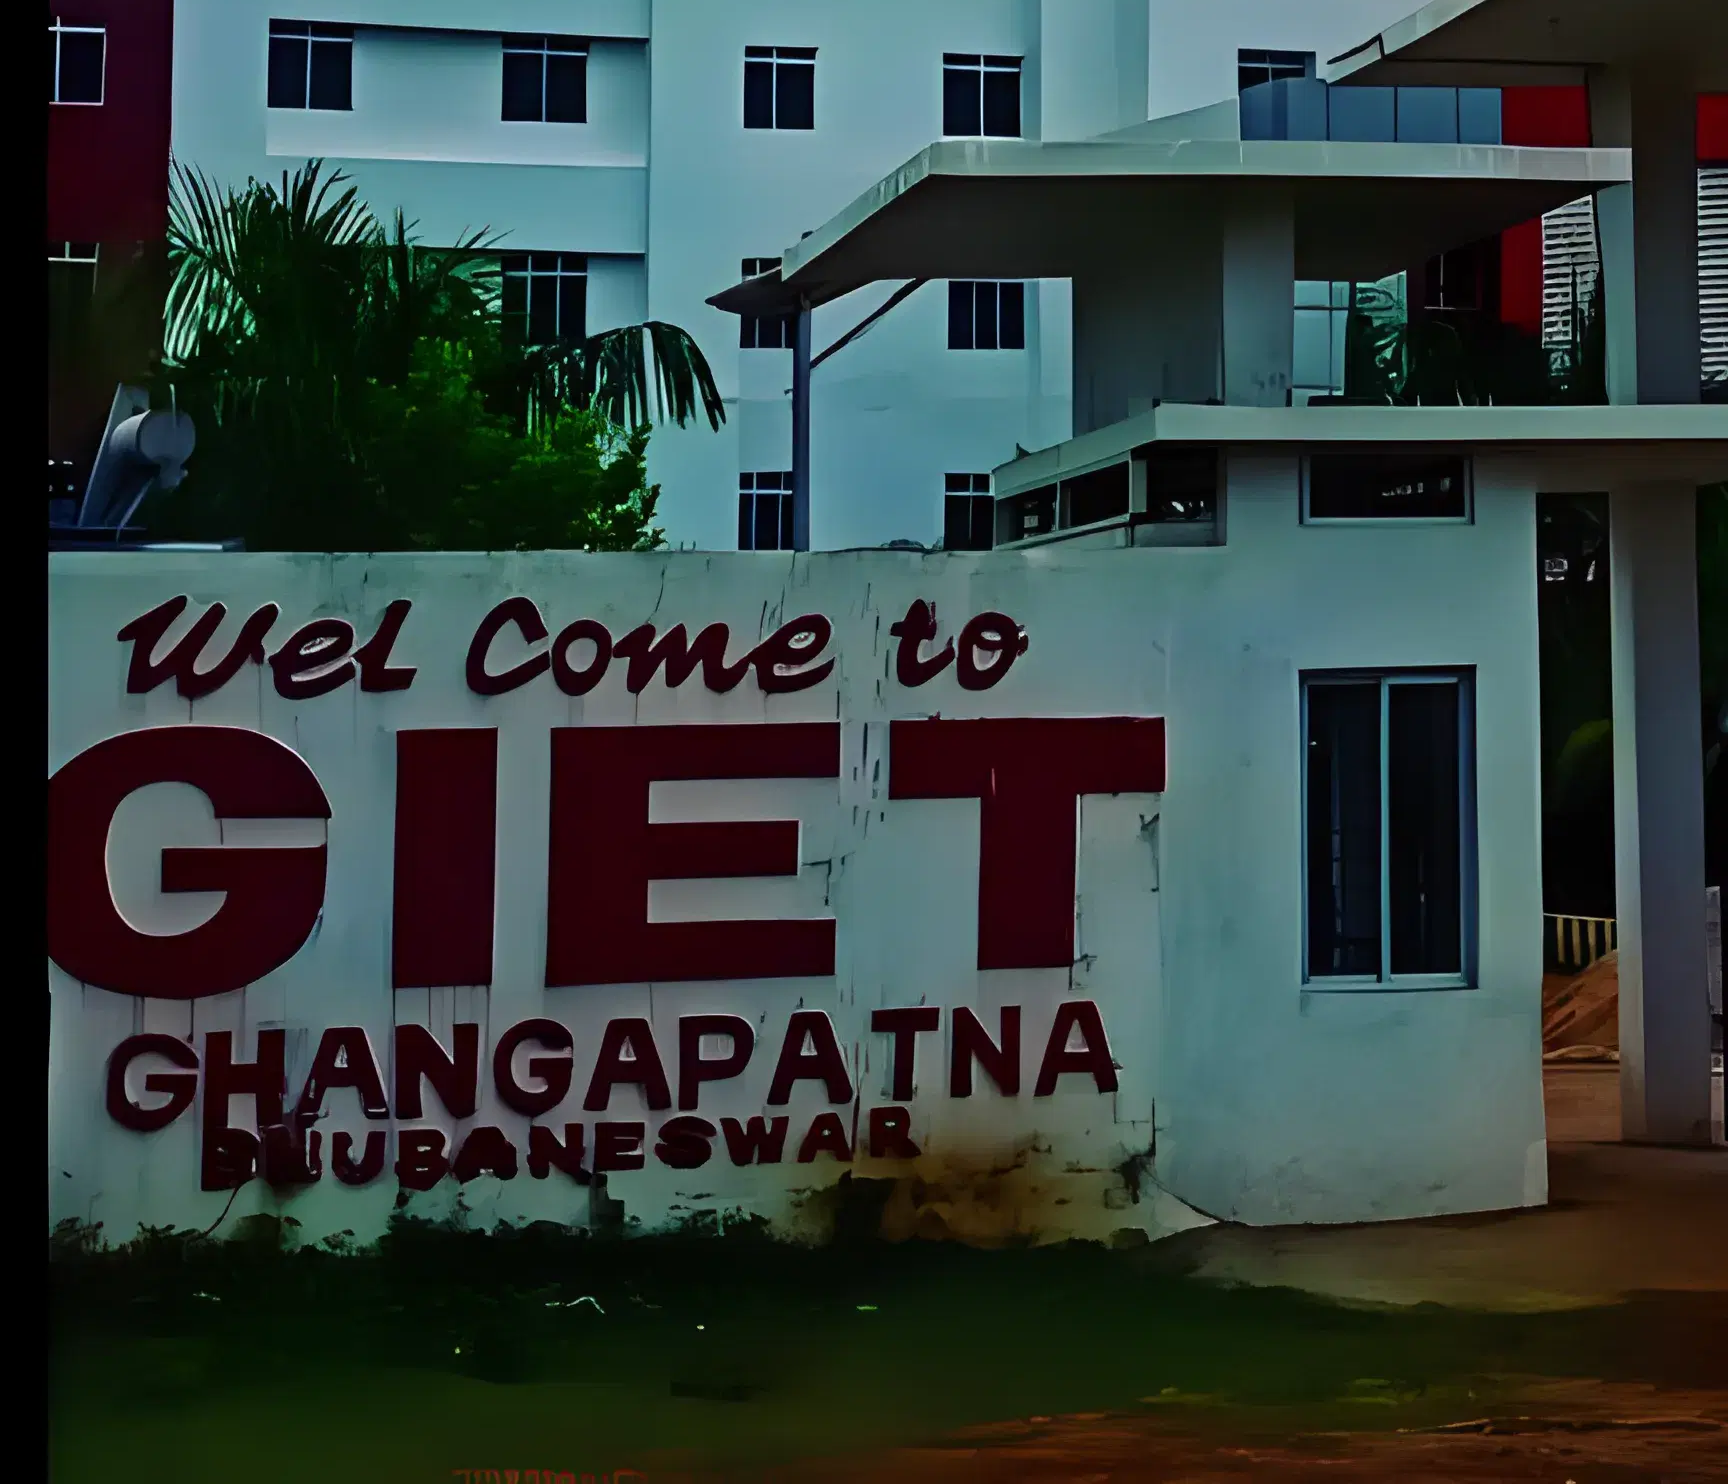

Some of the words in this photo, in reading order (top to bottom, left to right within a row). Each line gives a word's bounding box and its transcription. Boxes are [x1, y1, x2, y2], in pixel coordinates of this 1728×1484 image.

[465, 597, 833, 697] Come
[891, 599, 1028, 690] to
[48, 717, 1166, 999] GIET
[105, 1001, 1118, 1132] GHANGAPATNA
